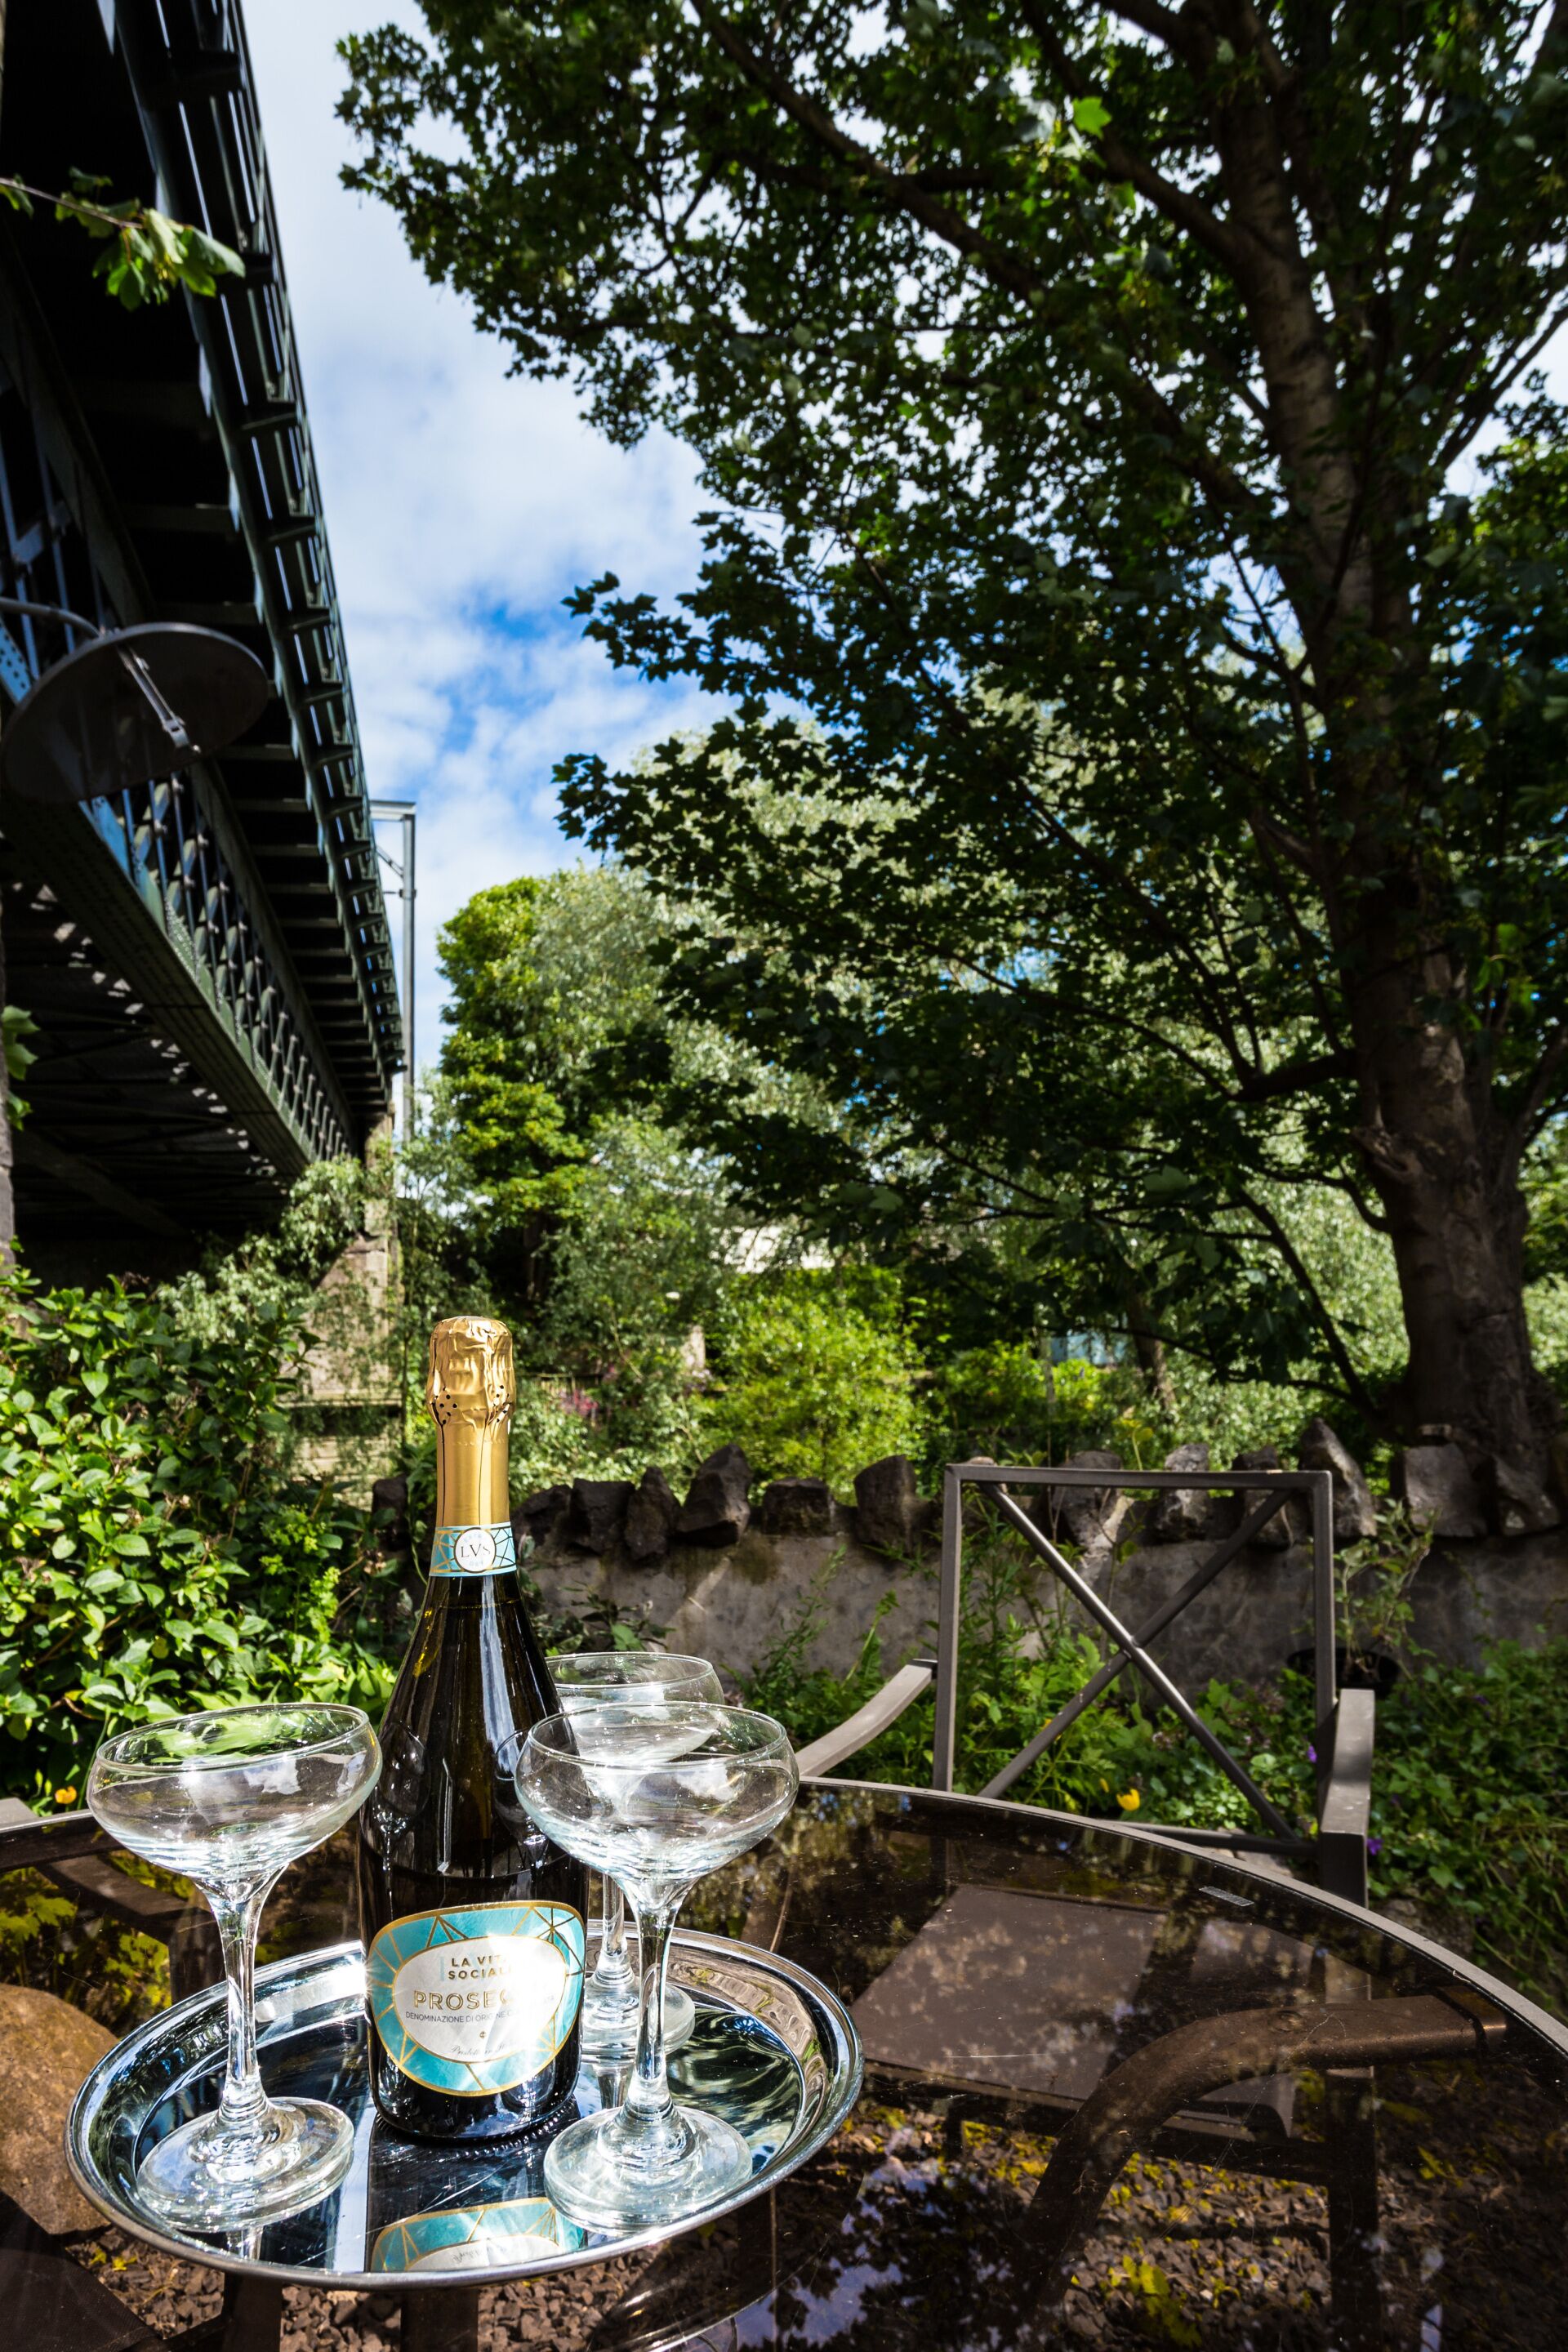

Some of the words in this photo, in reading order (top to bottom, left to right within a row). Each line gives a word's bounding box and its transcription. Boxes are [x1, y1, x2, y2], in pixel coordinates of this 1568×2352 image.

[461, 1544, 491, 1557] LVS
[451, 1958, 471, 1967] LA
[448, 1967, 511, 1980] SOCIAL
[405, 2011, 464, 2023] DENOMINAZIONE
